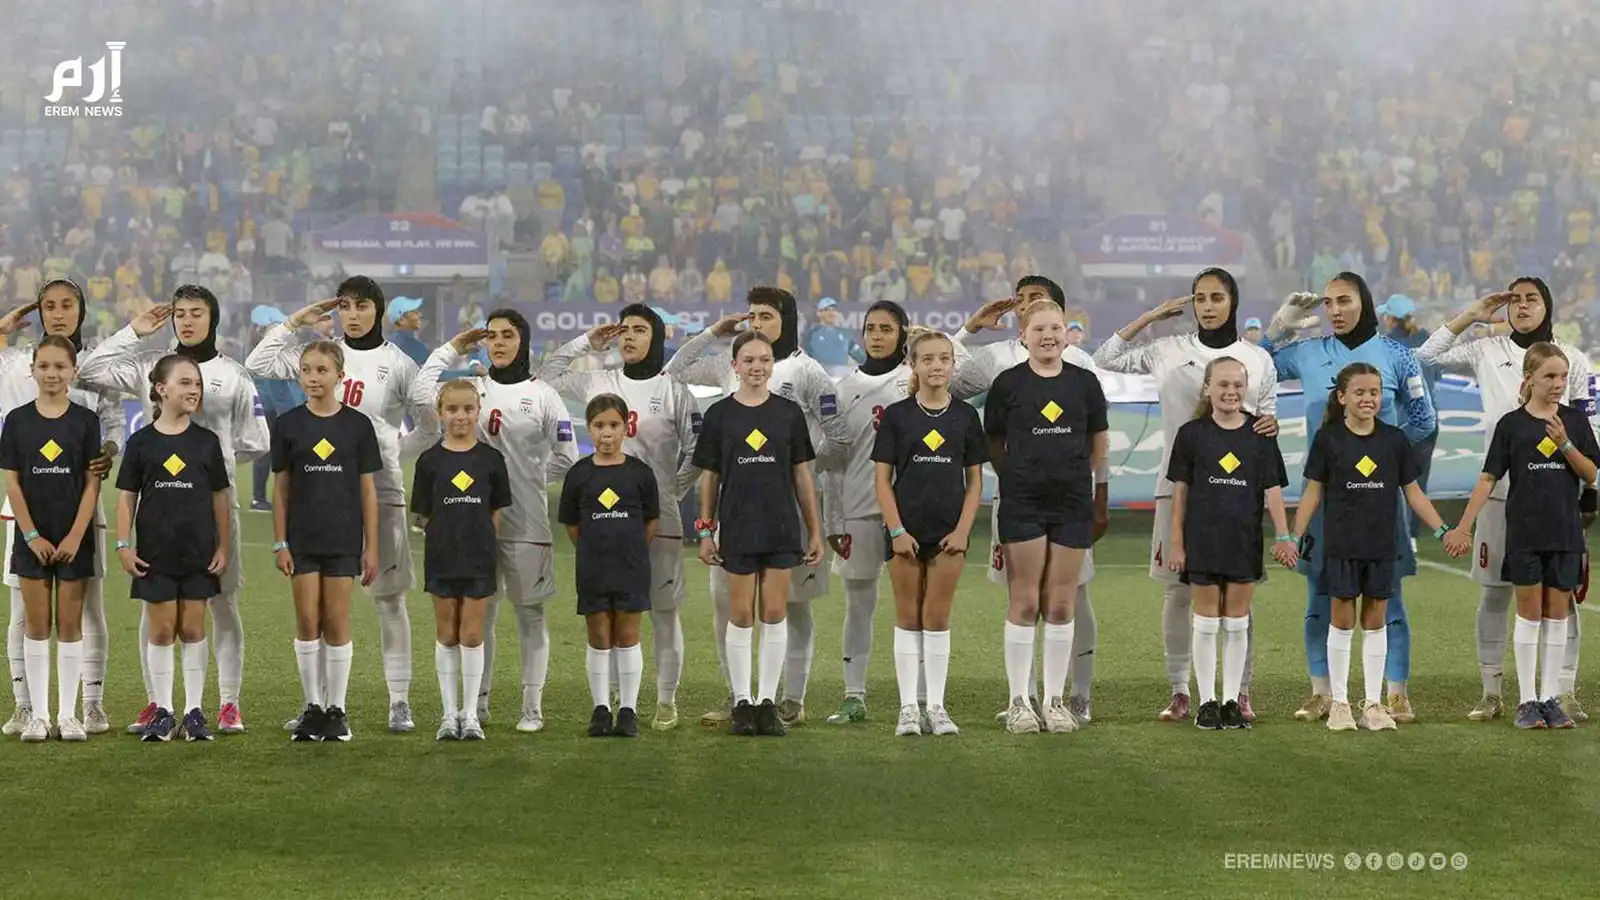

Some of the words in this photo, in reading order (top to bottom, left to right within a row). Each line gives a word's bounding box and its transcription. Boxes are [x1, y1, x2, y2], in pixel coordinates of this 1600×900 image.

[536, 312, 610, 330] GOLD
[343, 378, 365, 407] 16
[488, 408, 502, 436] 6
[1032, 426, 1071, 435] CommBank
[738, 455, 776, 465] CommBank
[913, 454, 952, 463] CommBank
[32, 466, 71, 475] CommBank
[304, 464, 343, 472] CommBank
[154, 480, 193, 489] CommBank
[1208, 476, 1247, 486] CommBank
[1346, 481, 1384, 489] CommBank
[443, 495, 481, 504] CommBank
[592, 511, 629, 520] CommBank
[1480, 542, 1488, 568] 9
